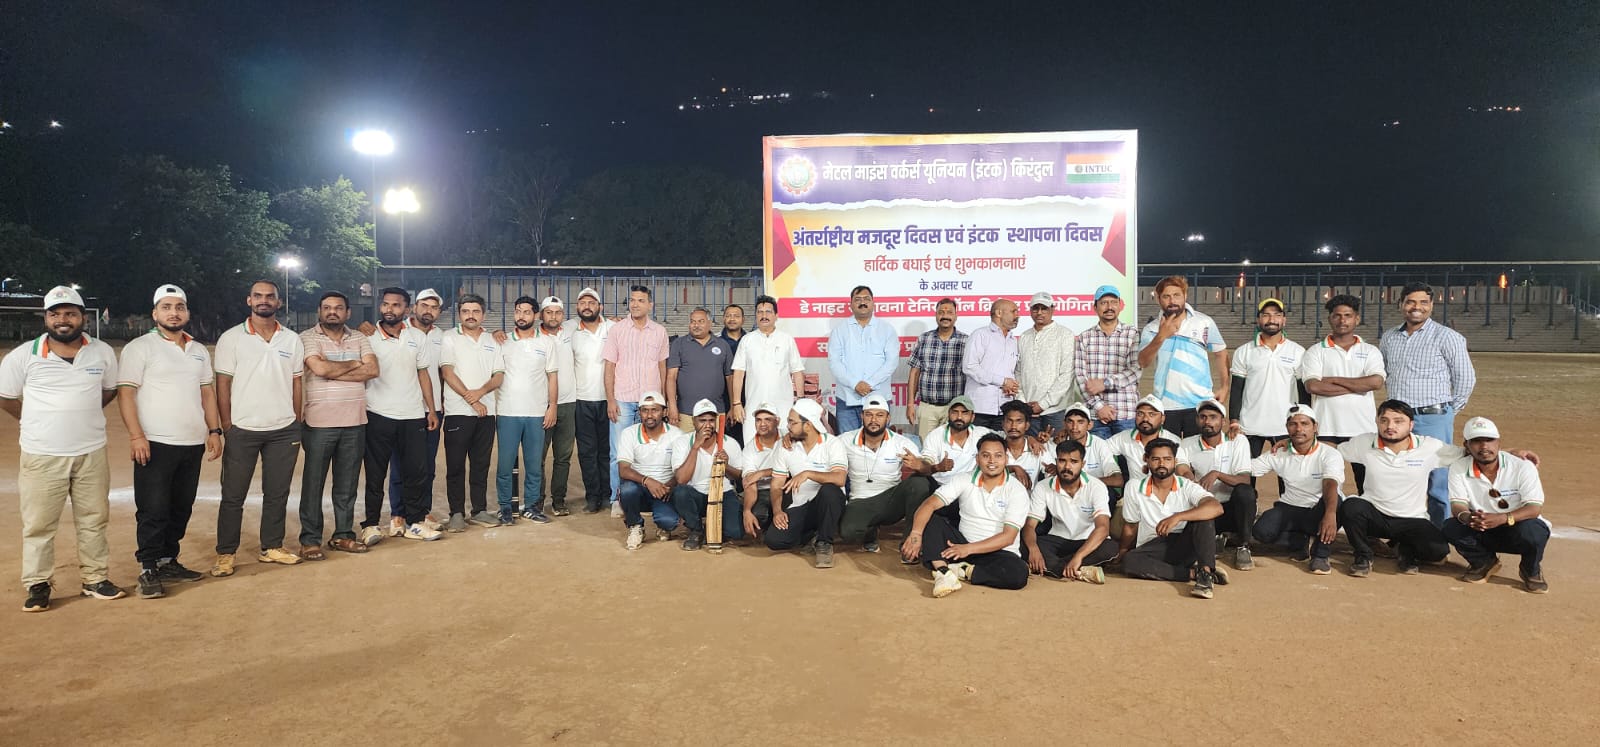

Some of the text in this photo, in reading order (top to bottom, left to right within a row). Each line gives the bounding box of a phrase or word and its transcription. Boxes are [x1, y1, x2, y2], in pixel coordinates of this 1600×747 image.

[822, 157, 1054, 184] मेटल माइंस वर्कर्स यूनियन (इंटक) किरंदुल
[1085, 164, 1113, 173] INTUC
[793, 222, 1104, 250] अंतर्राष्ट्रीय मजदूर दिवस एवं इंटक स्थापना दिवस
[864, 254, 1027, 274] हार्दिक बधाई एवं शुभकामनाएं
[918, 278, 973, 291] के अवसर पर
[799, 300, 810, 314] डे
[812, 302, 847, 315] नाइट
